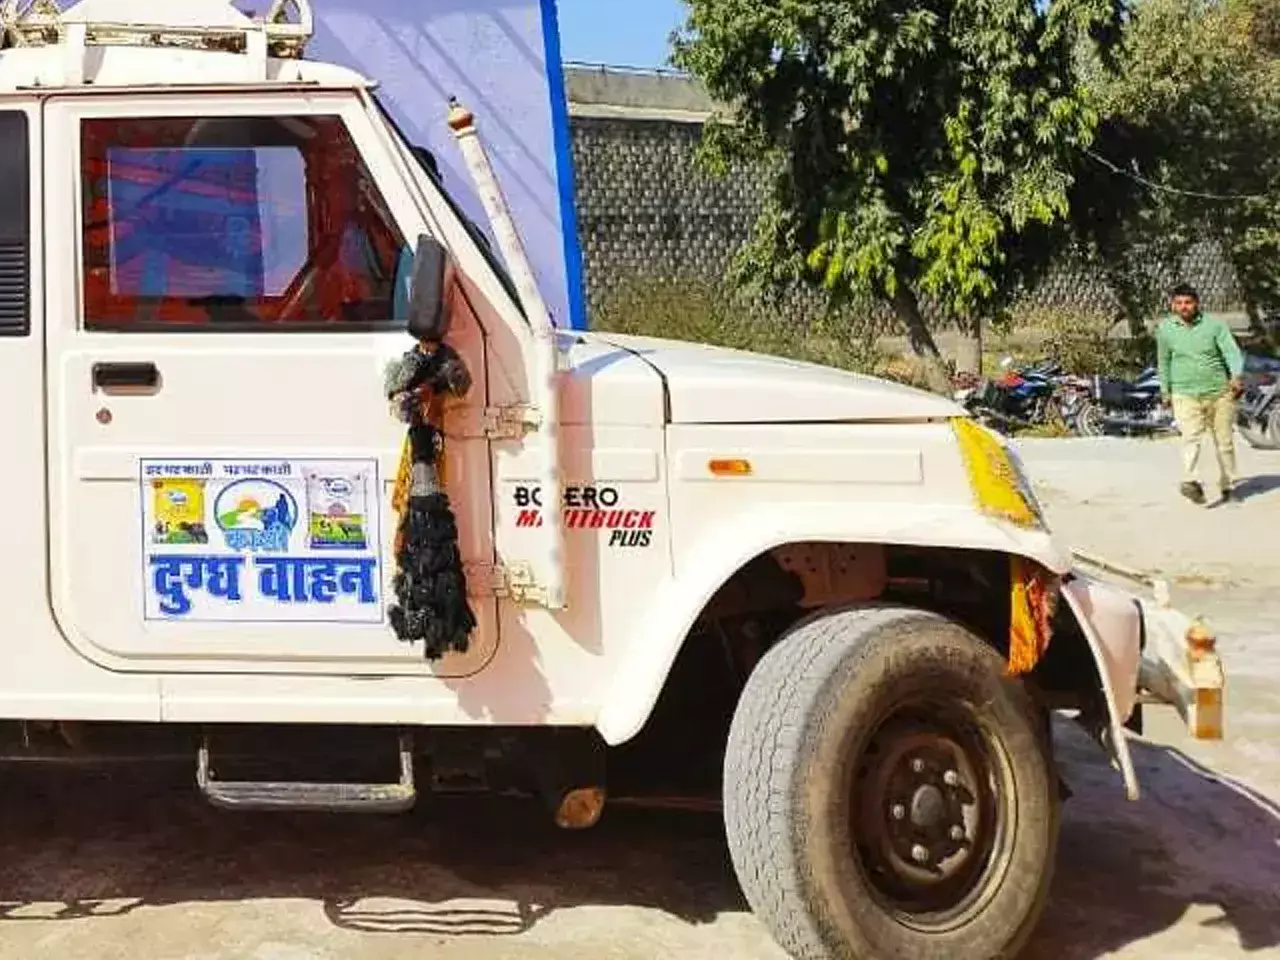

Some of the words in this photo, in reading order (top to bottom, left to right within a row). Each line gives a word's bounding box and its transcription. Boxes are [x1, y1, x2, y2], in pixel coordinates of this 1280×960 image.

[513, 486, 619, 510] BOERO
[515, 509, 656, 529] MITRUCK
[608, 529, 652, 547] PLUS
[150, 554, 246, 615] दुग्ध
[255, 556, 377, 604] वाहन
